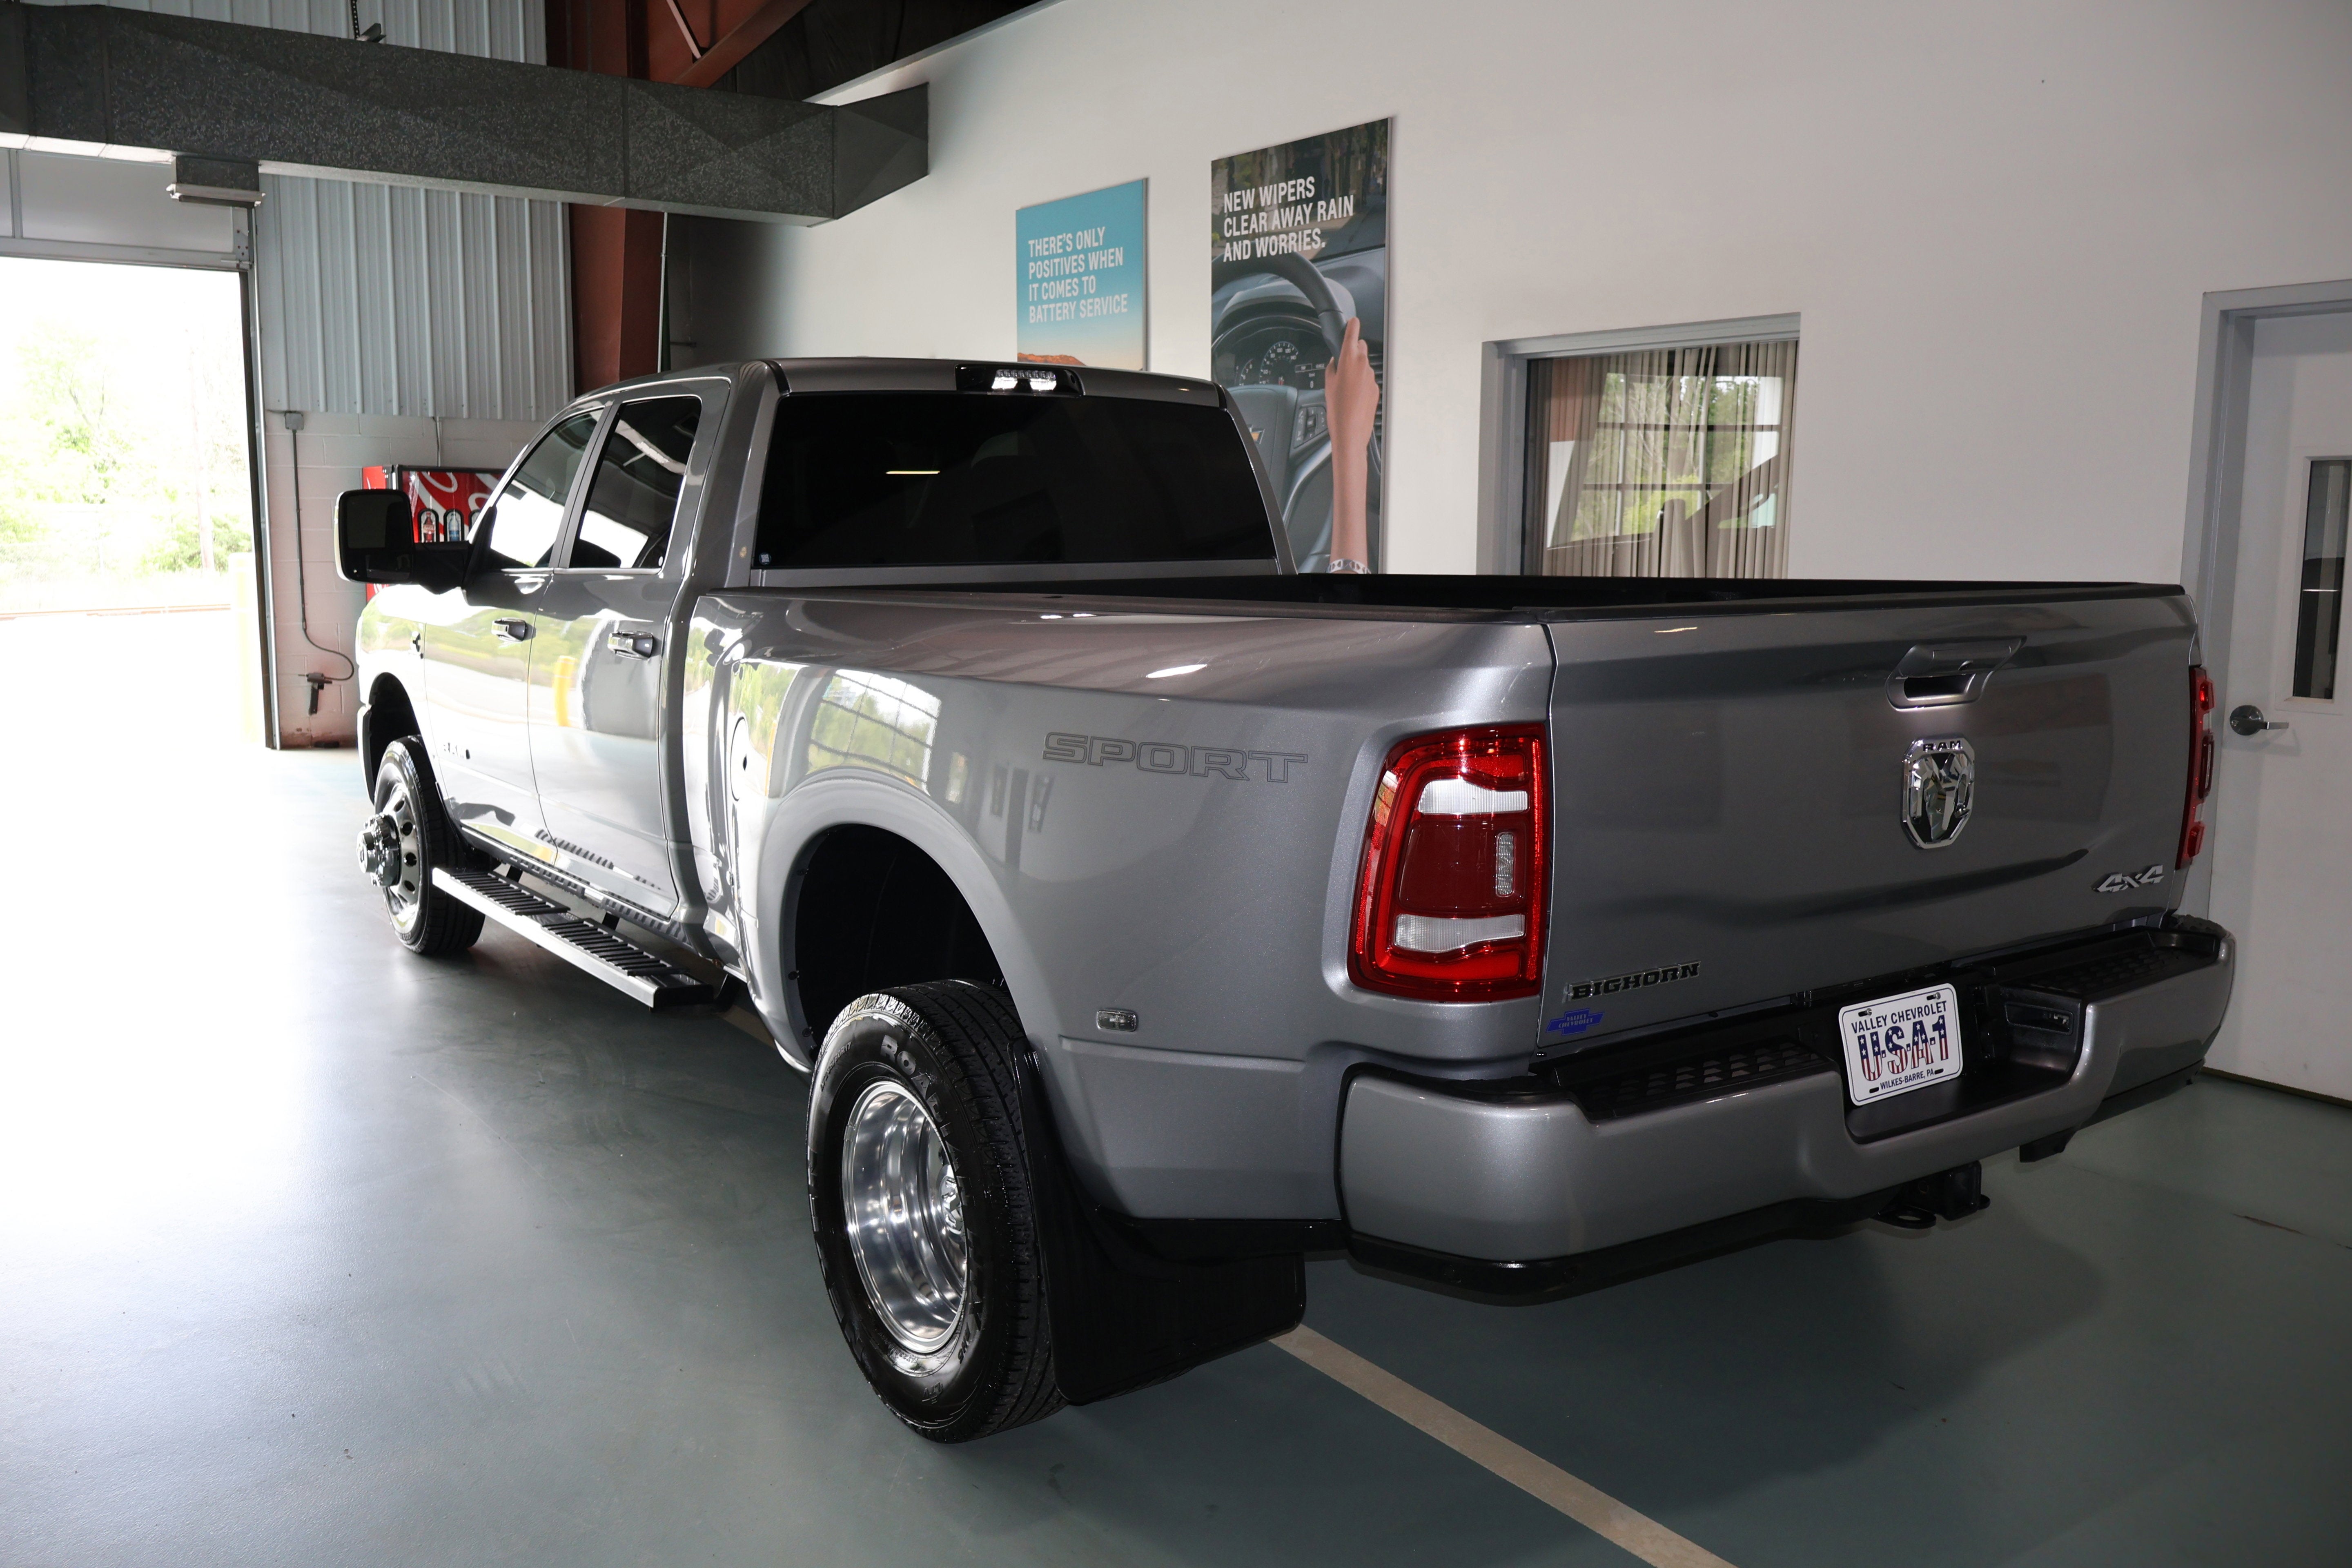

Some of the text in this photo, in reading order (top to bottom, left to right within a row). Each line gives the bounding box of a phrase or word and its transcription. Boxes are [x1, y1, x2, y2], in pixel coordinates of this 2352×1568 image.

[1224, 176, 1315, 213] NEW WIPERS
[1224, 194, 1354, 238] CLEAR AWAY RAIN
[1028, 226, 1105, 257] THERE'S ONLY
[1223, 228, 1326, 262] AND WORRIES.
[1029, 247, 1123, 280] POSITIVES WHEN
[1029, 275, 1096, 301] IT COMES TO
[1029, 293, 1128, 323] BATTERY SERVICE
[1043, 732, 1307, 783] SPORT
[1923, 739, 1962, 752] RAM
[1569, 961, 1701, 1001] BIGHORN
[1558, 1018, 1592, 1028] CHEVROLET
[1851, 1000, 1947, 1034] VALLEY CHEVROLET
[1880, 1068, 1934, 1090] WILKES-BARRE, PA
